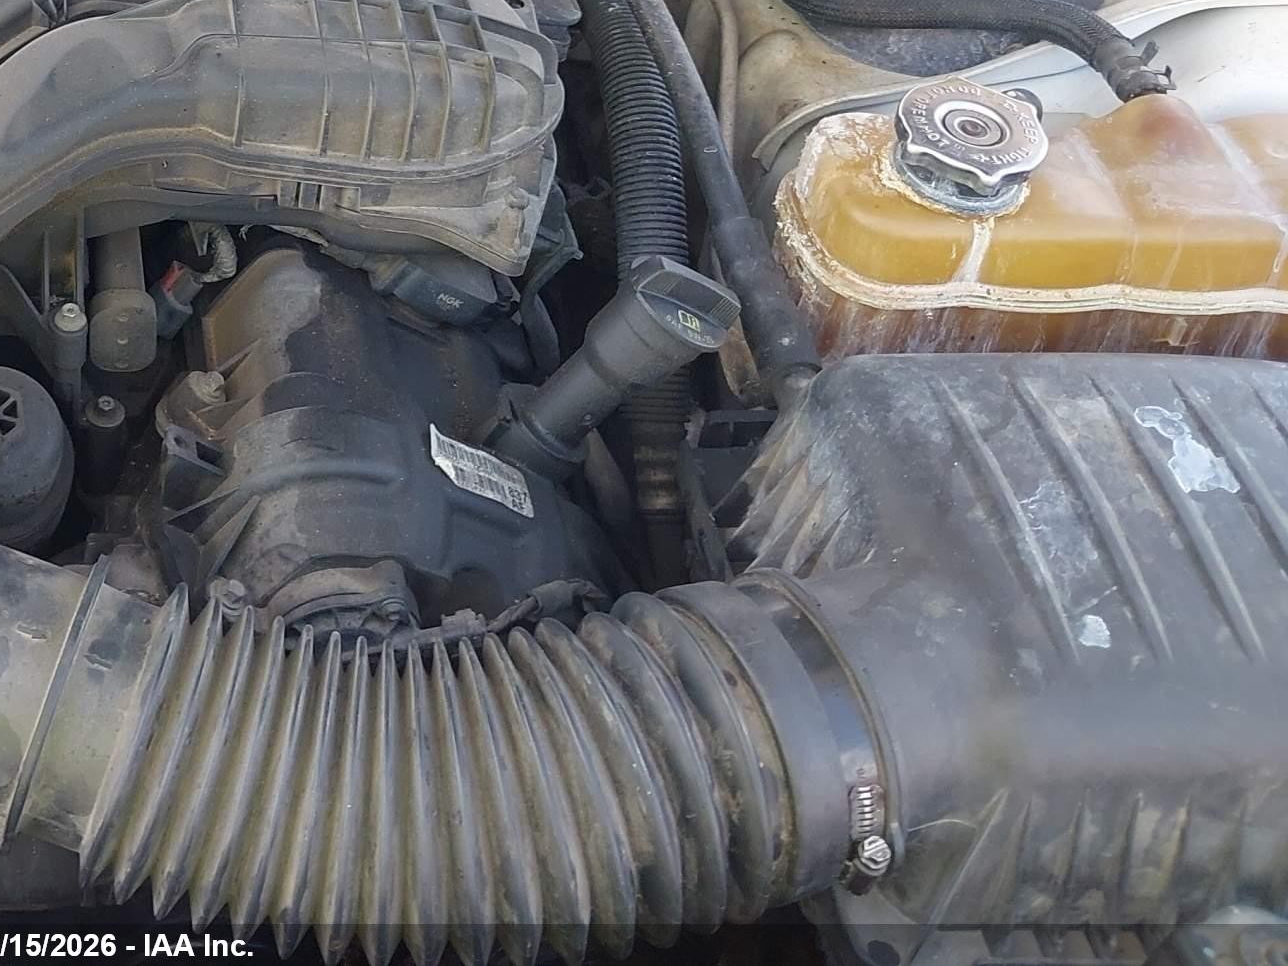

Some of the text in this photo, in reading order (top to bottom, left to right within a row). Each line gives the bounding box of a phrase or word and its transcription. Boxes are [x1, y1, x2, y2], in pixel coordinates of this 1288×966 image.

[990, 112, 1039, 165] KEEP TIGHT
[436, 292, 464, 308] NGK
